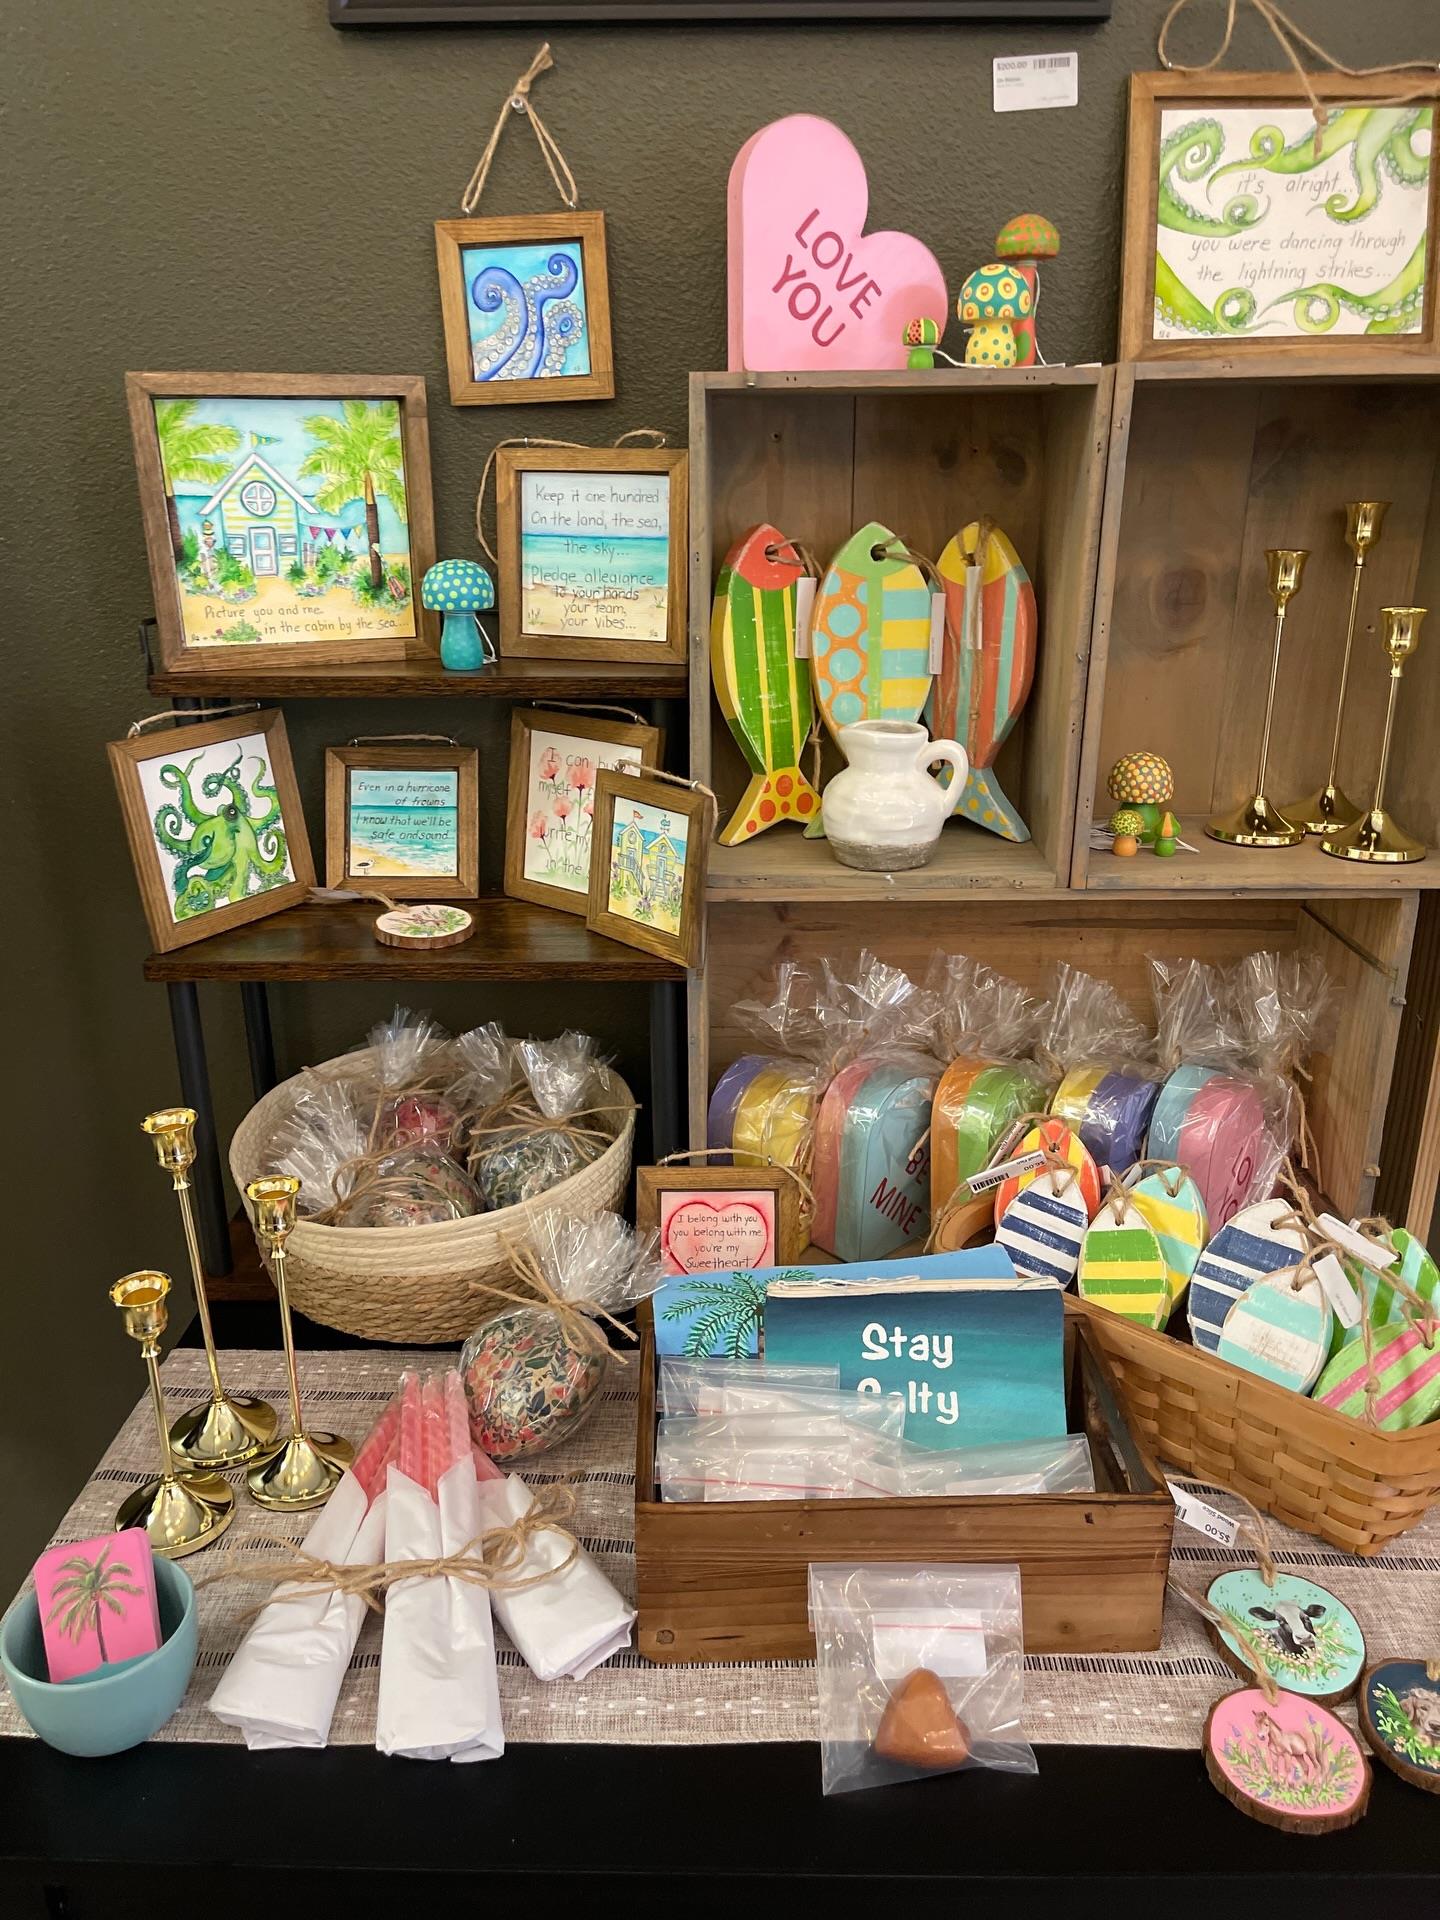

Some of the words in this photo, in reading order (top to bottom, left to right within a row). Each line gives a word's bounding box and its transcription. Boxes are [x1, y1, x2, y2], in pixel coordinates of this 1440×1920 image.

[1236, 174, 1264, 194] it's
[1187, 239, 1220, 261] you
[1228, 239, 1272, 251] were
[1279, 231, 1343, 259] dancing
[1349, 229, 1406, 256] through
[795, 208, 882, 319] LOVE
[1197, 264, 1224, 282] the
[1237, 259, 1307, 289] lightning
[772, 254, 846, 347] YOU
[535, 483, 565, 506] Keep
[571, 489, 580, 502] it
[585, 491, 608, 503] one
[610, 485, 660, 503] hundred
[530, 511, 547, 525] On
[550, 512, 572, 526] the
[612, 513, 634, 527] the
[563, 539, 588, 554] the
[530, 565, 577, 585] Pledge
[584, 567, 656, 586] allegiance
[572, 588, 600, 604] your
[603, 585, 640, 600] hands
[204, 604, 246, 619] Picture
[253, 608, 273, 623] you
[278, 605, 299, 616] and
[563, 603, 590, 617] your
[264, 622, 276, 635] in
[280, 621, 300, 634] the
[304, 619, 335, 632] cabin
[338, 616, 352, 635] by
[356, 617, 373, 629] the
[560, 618, 588, 630] your
[547, 746, 557, 762] I
[565, 754, 589, 768] can
[358, 781, 381, 792] Even
[385, 784, 395, 792] in
[397, 784, 404, 792] a
[406, 780, 451, 793] hurricane
[539, 779, 572, 800] myself
[394, 796, 408, 806] of
[412, 796, 446, 807] frowns
[355, 812, 360, 825] I
[362, 814, 388, 825] know
[390, 814, 411, 826] that
[413, 815, 437, 826] we'll
[438, 816, 452, 827] be
[370, 829, 395, 840] safe
[562, 857, 582, 875] the
[870, 1177, 922, 1235] MINE
[677, 1214, 684, 1223] I
[687, 1213, 718, 1227] belong
[722, 1213, 742, 1223] with
[744, 1215, 758, 1226] you
[672, 1229, 689, 1241] you
[693, 1226, 724, 1242] belong
[726, 1227, 747, 1237] with
[694, 1243, 722, 1257] you're
[726, 1244, 740, 1257] my
[861, 1322, 953, 1369] Stay
[1202, 1505, 1216, 1518] Slice
[1216, 1514, 1235, 1528] Wood
[1205, 1524, 1230, 1543] $5.00
